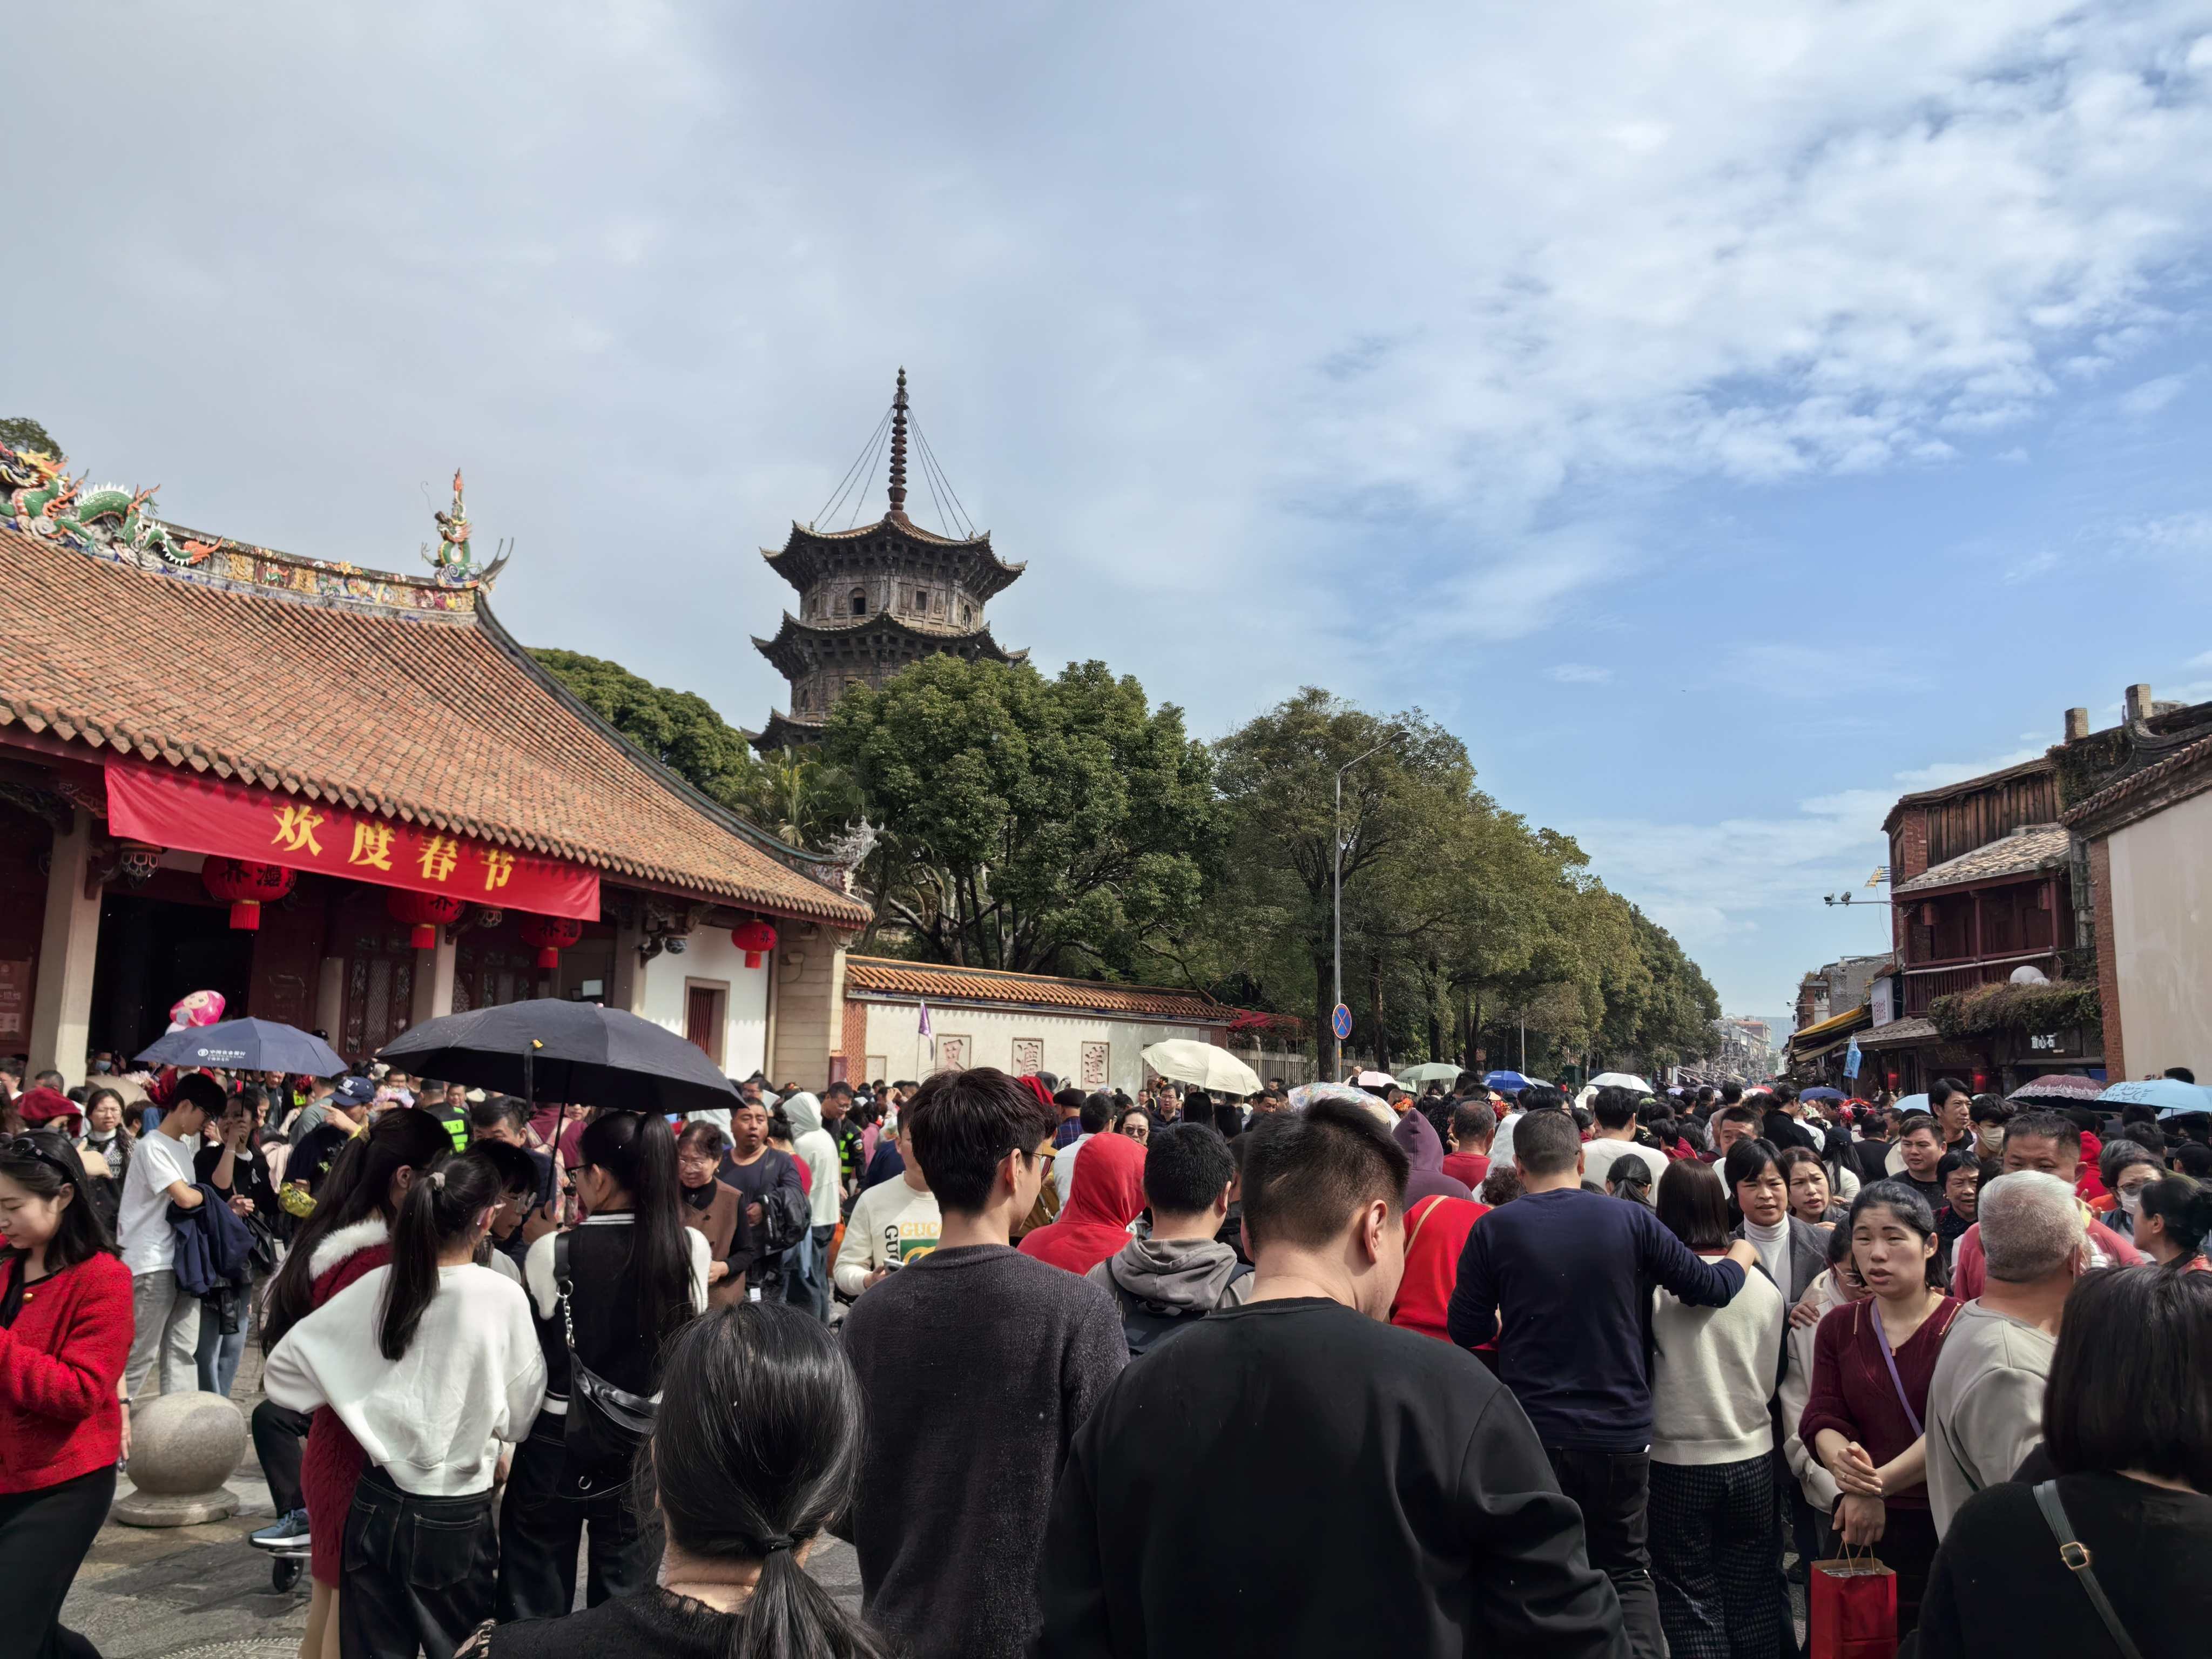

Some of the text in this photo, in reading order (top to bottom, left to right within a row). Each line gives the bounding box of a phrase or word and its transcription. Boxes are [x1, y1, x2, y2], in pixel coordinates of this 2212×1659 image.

[271, 805, 515, 891] 欢度春节
[1084, 1046, 1105, 1084] 蓮
[899, 1221, 942, 1237] GUC
